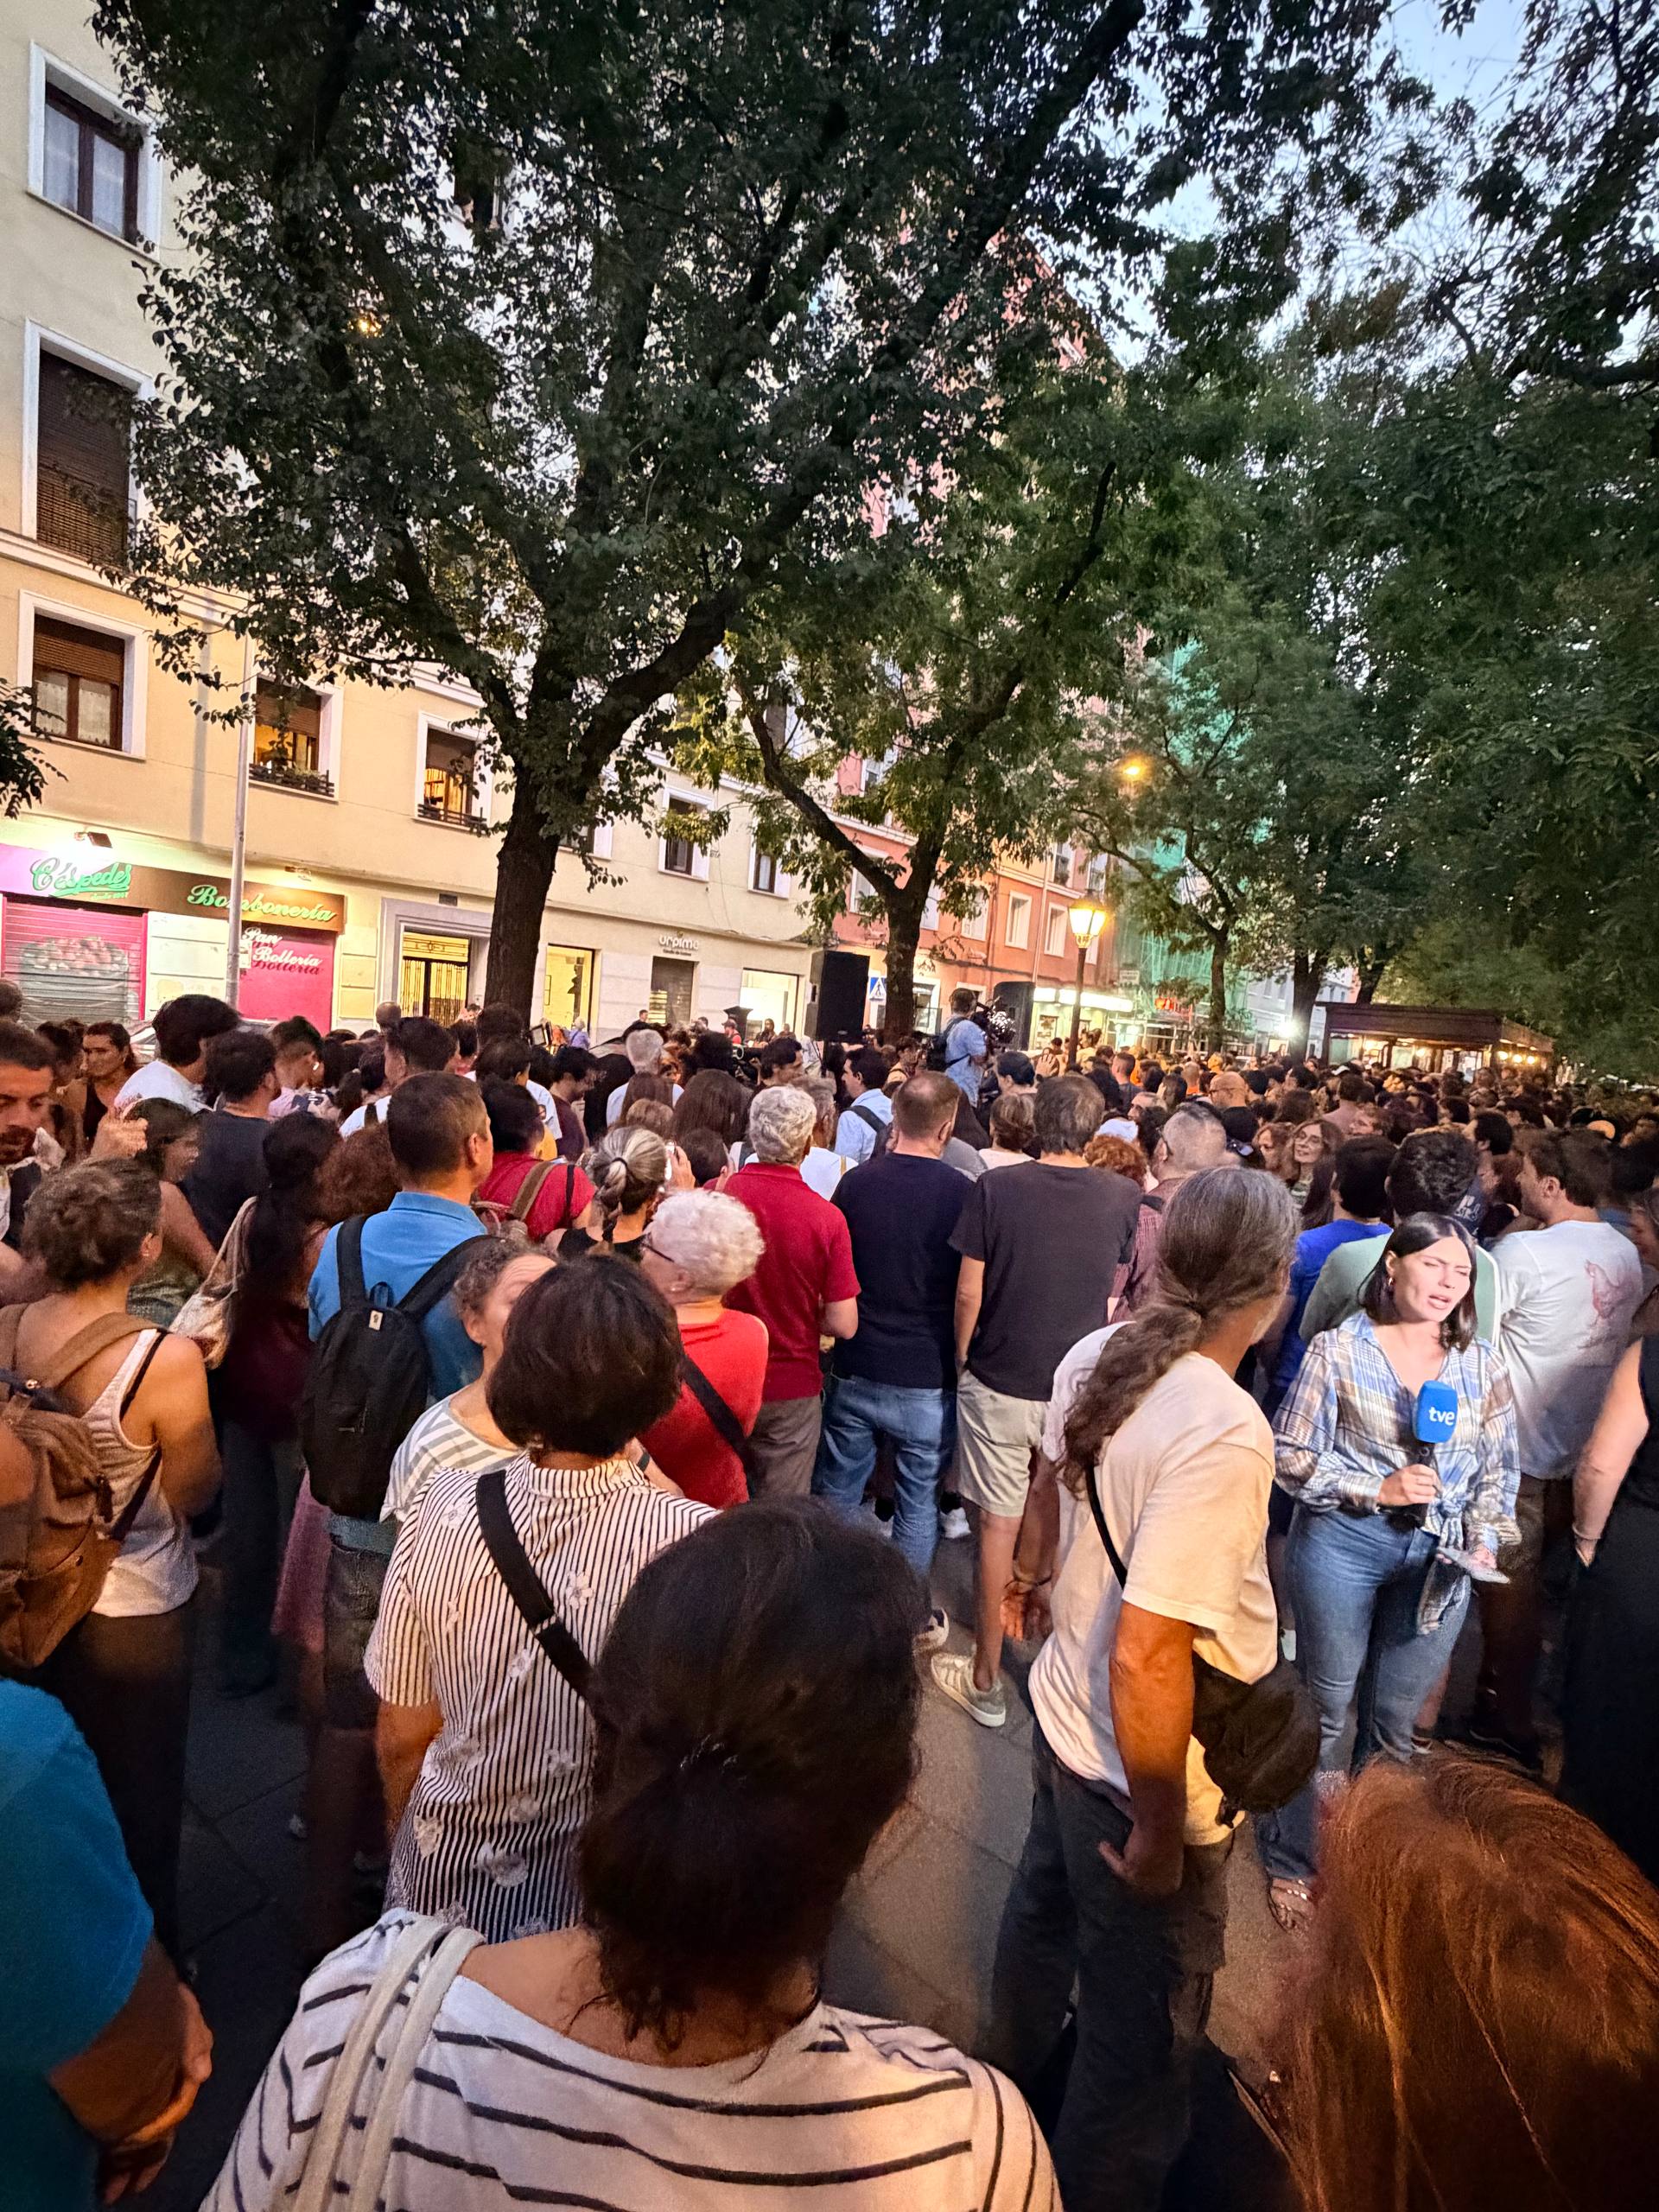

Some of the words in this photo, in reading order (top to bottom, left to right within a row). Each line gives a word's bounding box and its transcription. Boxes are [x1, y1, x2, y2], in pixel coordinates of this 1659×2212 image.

[242, 926, 283, 945] Pan
[252, 946, 323, 967] Bollería
[1428, 1406, 1455, 1427] tve
